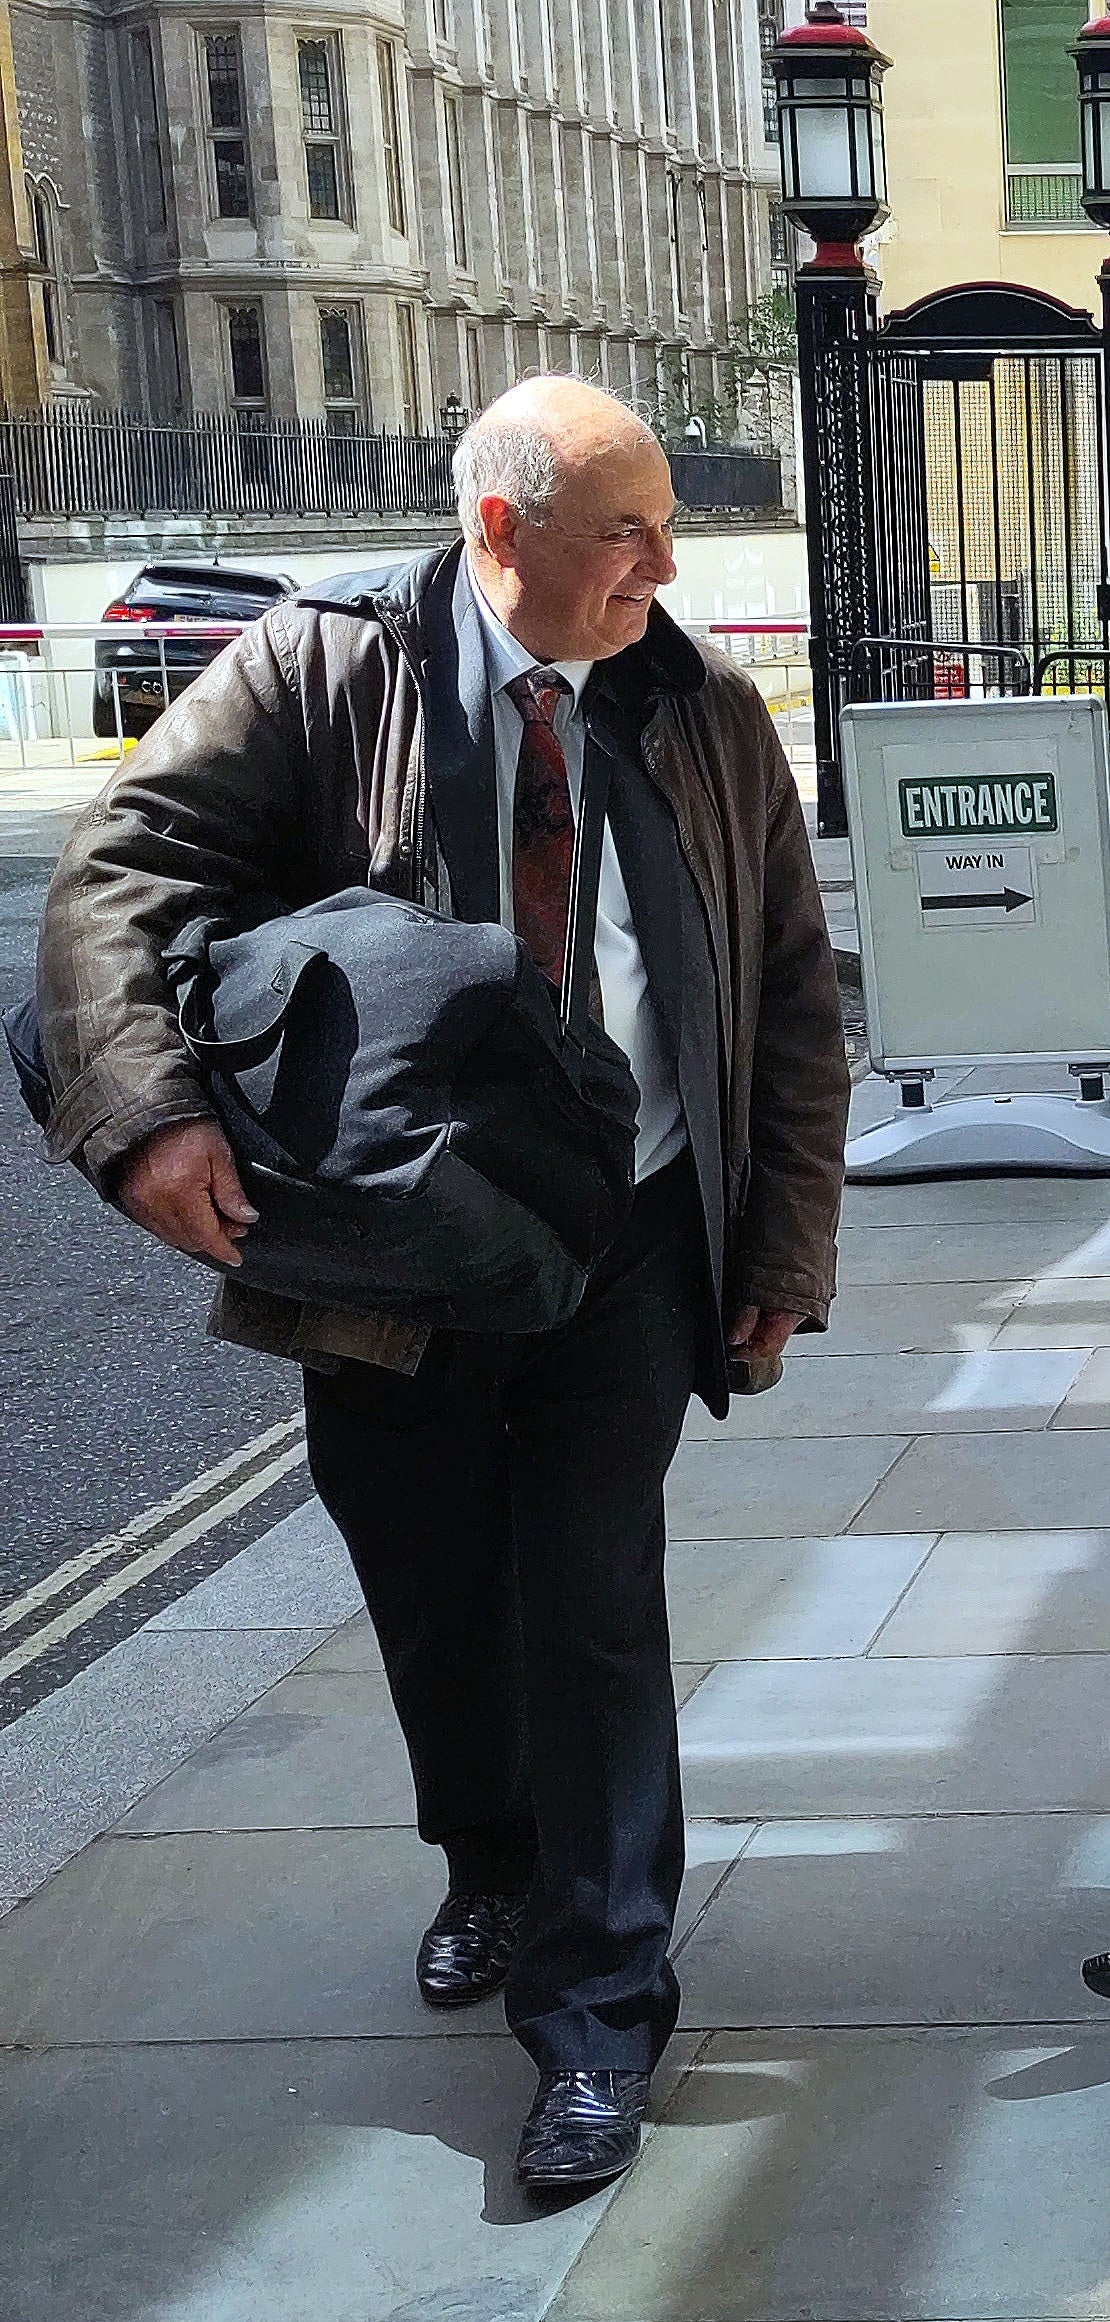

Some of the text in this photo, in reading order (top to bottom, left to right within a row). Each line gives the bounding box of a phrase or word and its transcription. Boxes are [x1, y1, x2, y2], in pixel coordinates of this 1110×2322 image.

[906, 782, 1051, 828] ENTRANCE
[945, 854, 1004, 870] WAY IN
